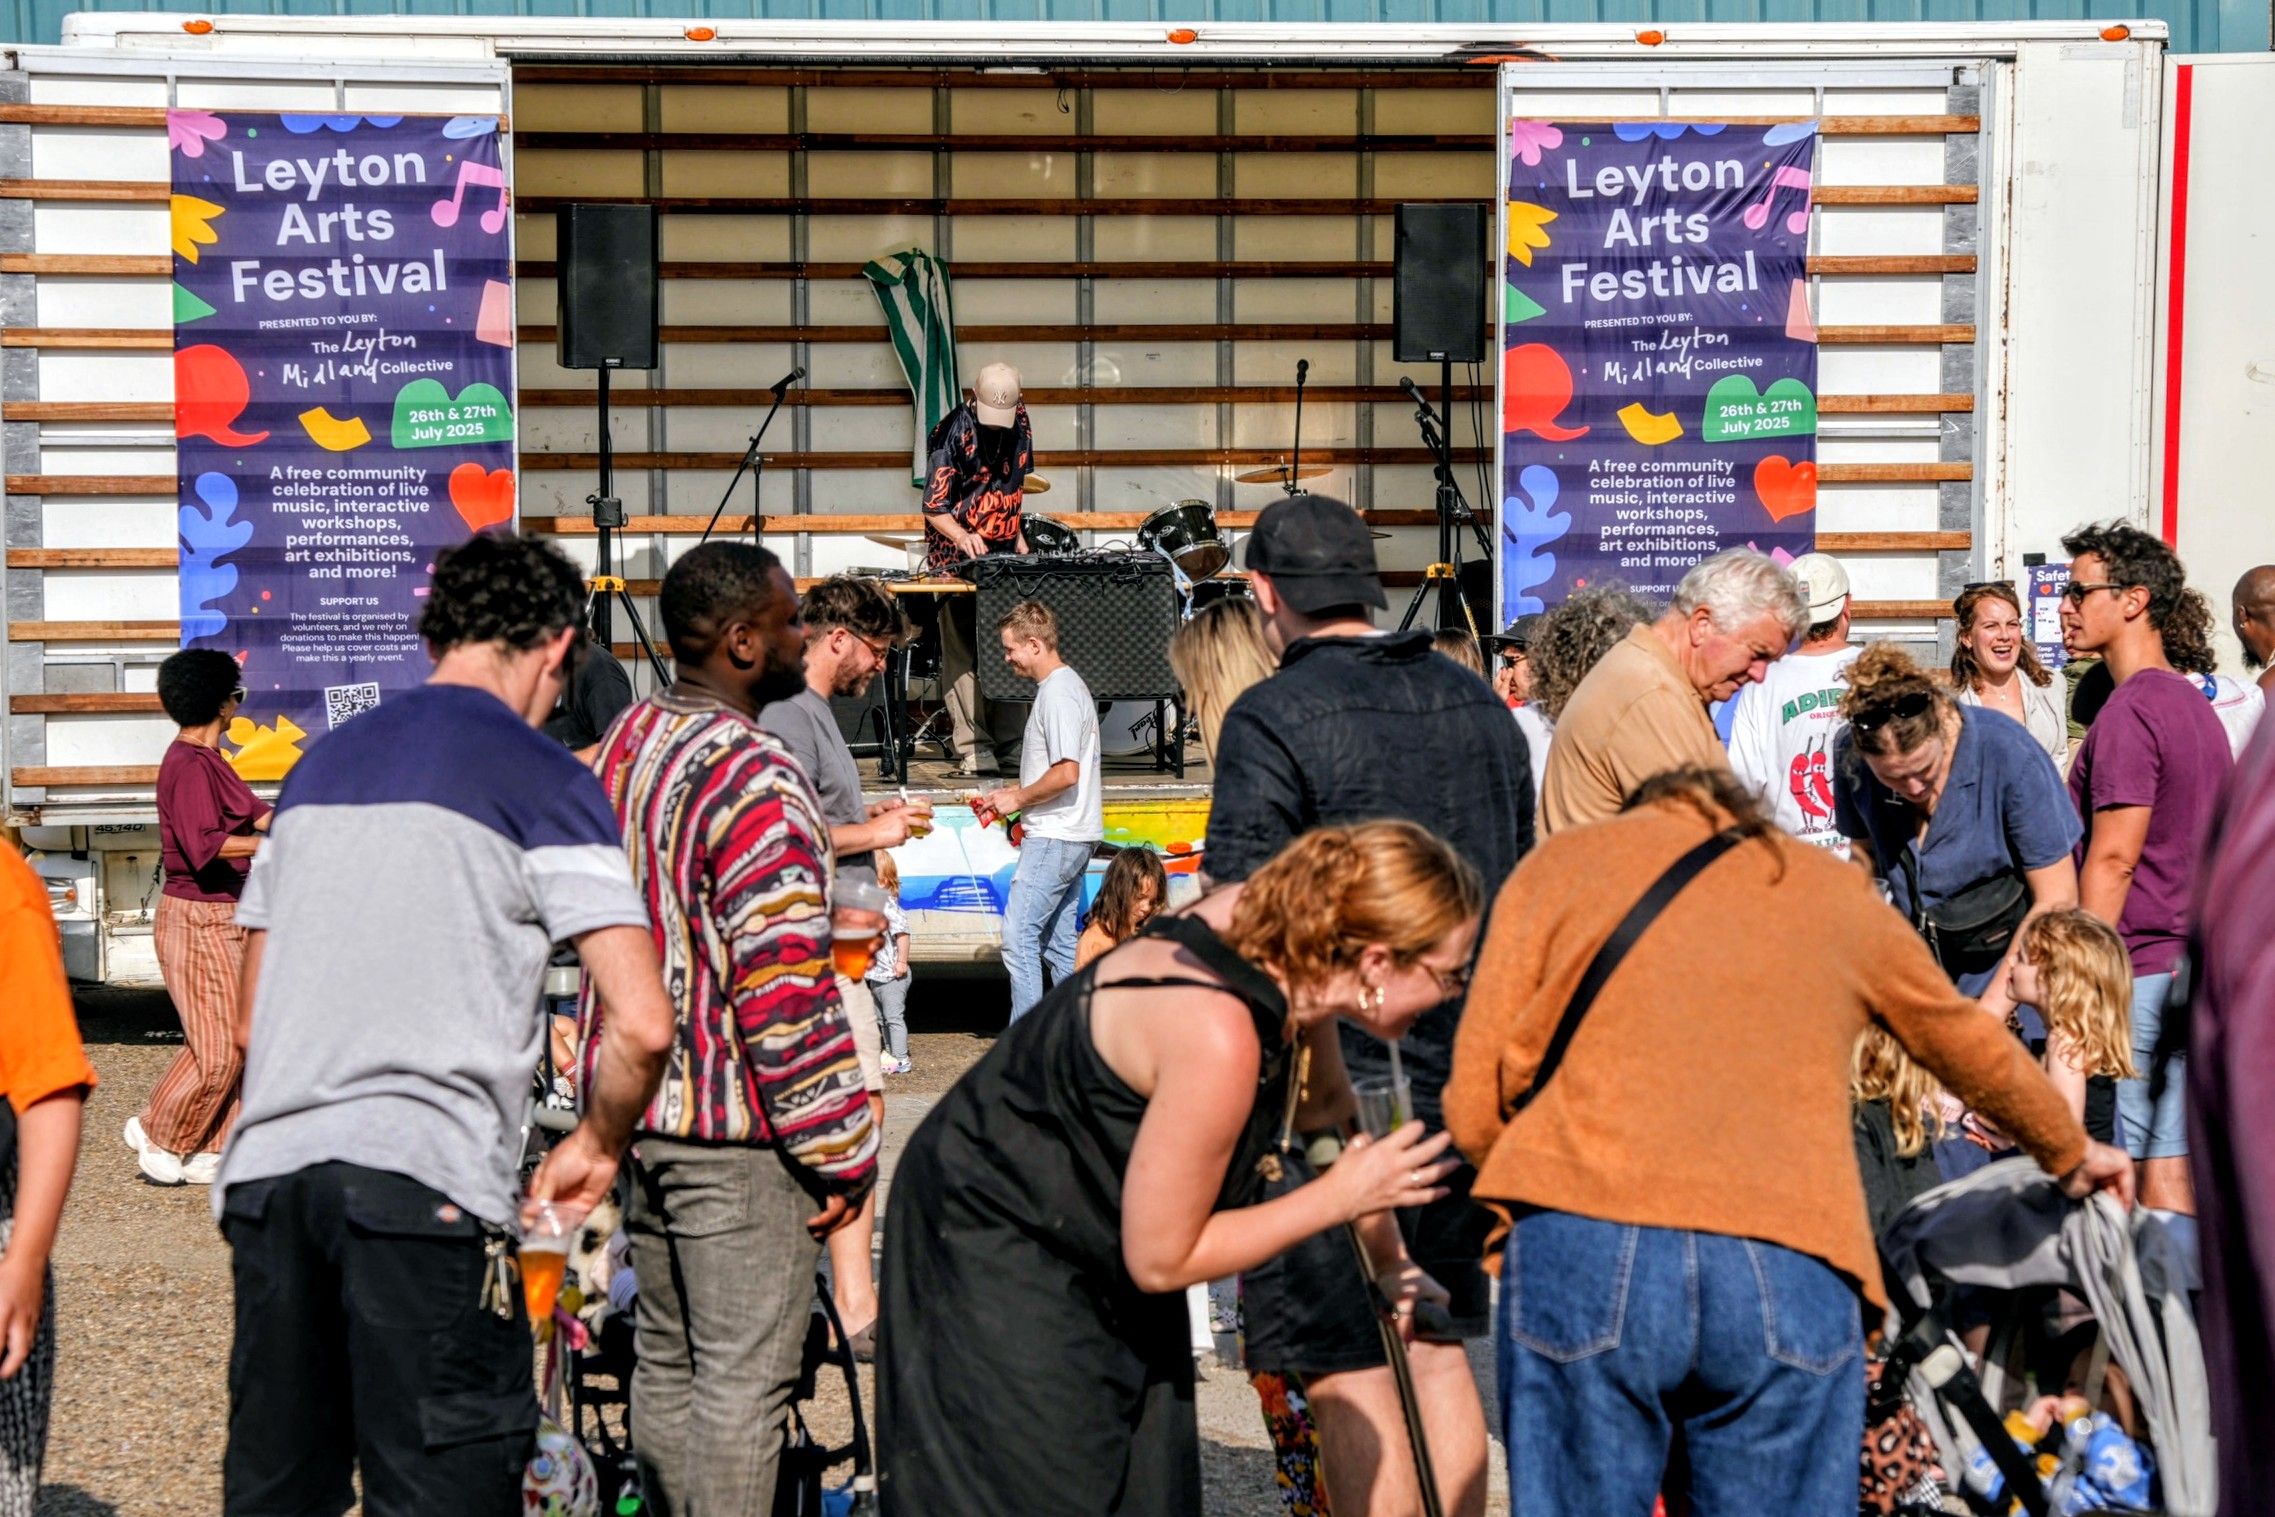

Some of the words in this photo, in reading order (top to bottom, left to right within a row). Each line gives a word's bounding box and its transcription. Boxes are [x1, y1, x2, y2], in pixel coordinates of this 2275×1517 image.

[232, 149, 426, 201] Leyton
[1566, 155, 1744, 206] Leyton
[276, 203, 395, 245] Arts
[1603, 208, 1709, 248] Arts
[231, 249, 447, 303] Festival
[1562, 250, 1758, 303] Festival
[259, 317, 319, 330] PRESENTED
[321, 316, 336, 326] TO
[337, 314, 360, 325] YOU
[361, 313, 378, 324] BY:
[1585, 317, 1639, 329] PRESENTED
[1641, 316, 1654, 325] TO
[1656, 314, 1677, 324] YOU
[1678, 313, 1693, 322] BY:
[311, 341, 340, 354] The
[342, 328, 416, 365] Leyton
[1631, 340, 1657, 352] The
[1659, 326, 1729, 362] Leyton
[282, 358, 379, 388] Midland
[381, 360, 454, 374] Collective
[1604, 356, 1693, 385] Midland
[1695, 356, 1763, 372] Collective
[409, 408, 445, 423] 26th
[448, 407, 460, 421] &
[463, 405, 496, 419] 27th
[1719, 403, 1753, 418] 26th
[1756, 402, 1767, 414] &
[1770, 399, 1802, 413] 27th
[411, 427, 443, 442] July
[446, 422, 485, 437] 2025
[1721, 419, 1751, 435] July
[1754, 416, 1790, 431] 2025
[270, 466, 283, 480] A
[286, 465, 322, 480] free
[327, 465, 426, 483] community
[1588, 459, 1600, 472] A
[1604, 459, 1637, 472] free
[1641, 458, 1734, 475] community
[272, 482, 374, 496] celebration
[378, 482, 395, 496] of
[399, 482, 429, 496] live
[1590, 475, 1684, 488] celebration
[1688, 474, 1704, 488] of
[1708, 474, 1735, 487] live
[1590, 491, 1643, 506] music,
[1647, 490, 1735, 504] interactive
[272, 499, 330, 514] music,
[334, 499, 430, 512] interactive
[1616, 506, 1708, 522] workshops,
[302, 515, 401, 532] workshops,
[1601, 523, 1720, 539] performances,
[286, 532, 414, 549] performances,
[1599, 540, 1622, 551] art
[1626, 538, 1721, 552] exhibitions,
[285, 551, 311, 562] art
[314, 548, 416, 563] exhibitions,
[1620, 554, 1650, 567] and
[1654, 554, 1702, 567] more!
[309, 565, 342, 578] and
[346, 565, 397, 578] more!
[2036, 570, 2071, 582] Safet
[1630, 585, 1671, 593] SUPPORT
[320, 597, 364, 605] SUPPORT
[366, 597, 379, 605] US
[290, 612, 307, 621] The
[308, 612, 340, 621] festival
[342, 612, 350, 621] is
[352, 612, 396, 623] organised
[398, 612, 409, 622] by
[292, 623, 341, 632] volunteers,
[343, 622, 360, 631] and
[377, 622, 393, 632] rely
[280, 633, 324, 641] donations
[338, 633, 362, 641] make
[365, 633, 381, 641] this
[282, 643, 311, 652] Please
[313, 643, 332, 653] help
[374, 643, 399, 651] costs
[401, 643, 418, 651] and
[296, 654, 320, 662] make
[322, 653, 339, 662] this
[349, 653, 375, 663] yearly
[377, 653, 404, 661] event.
